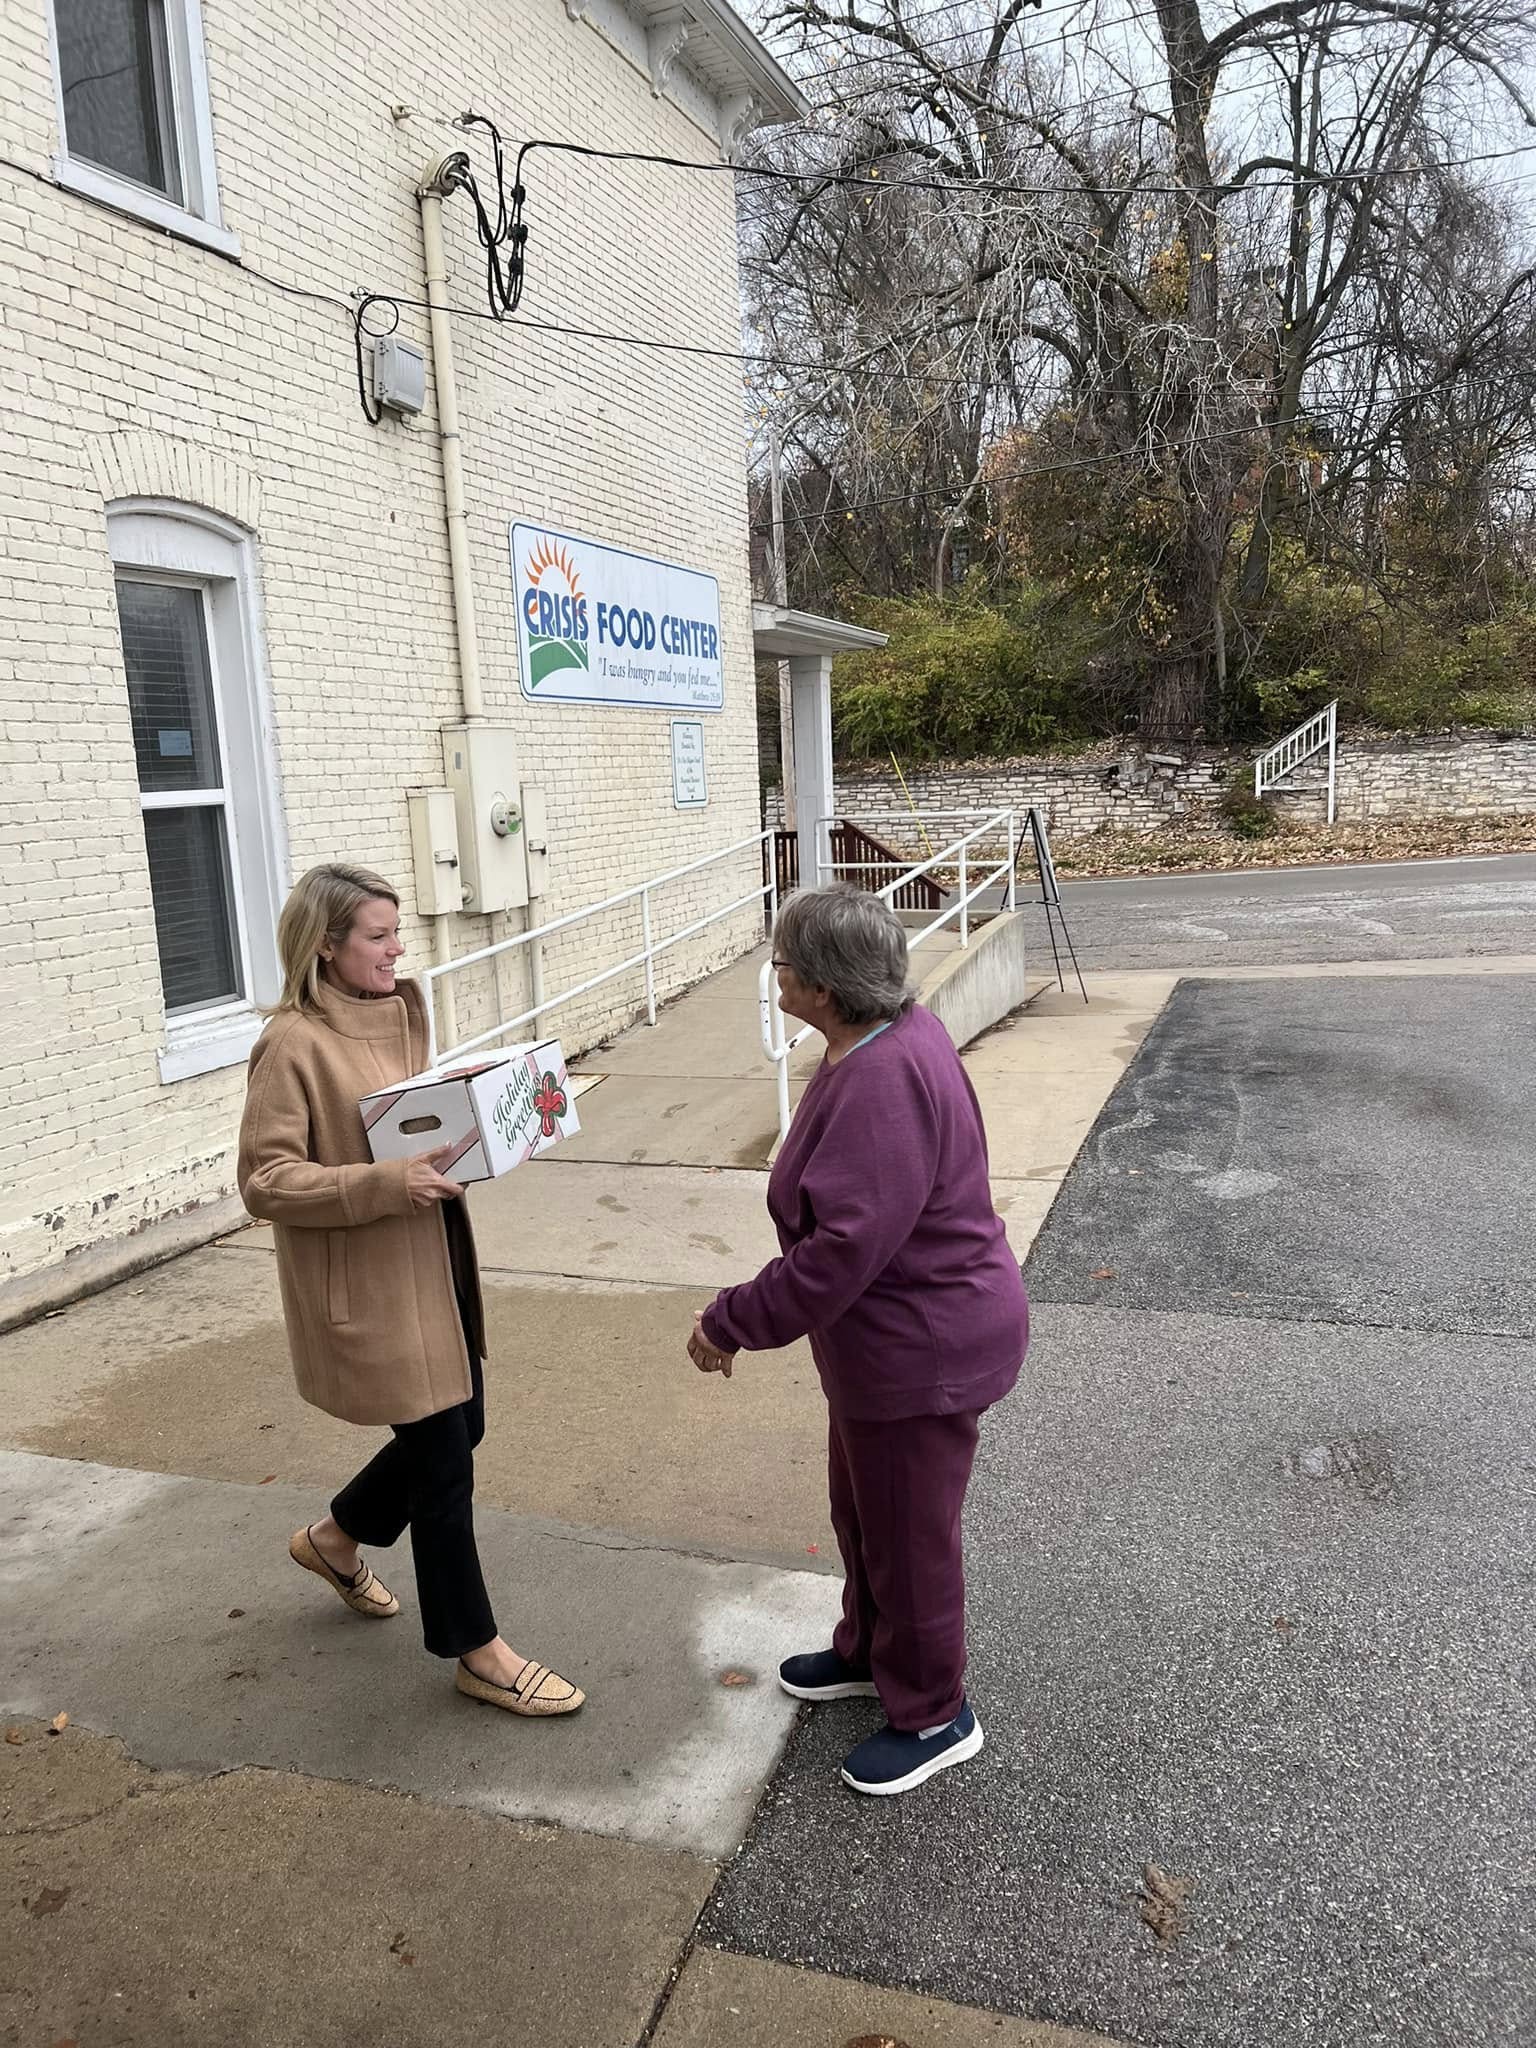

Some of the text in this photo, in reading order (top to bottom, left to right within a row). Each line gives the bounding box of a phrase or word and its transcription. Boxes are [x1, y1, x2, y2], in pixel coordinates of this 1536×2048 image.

[523, 587, 719, 660] CRISIS FOOD CENTER
[608, 664, 626, 677] was
[627, 659, 656, 686] hungry
[657, 665, 672, 682] and
[673, 670, 687, 688] you
[687, 666, 699, 690] fed
[493, 1061, 531, 1134] Holiday
